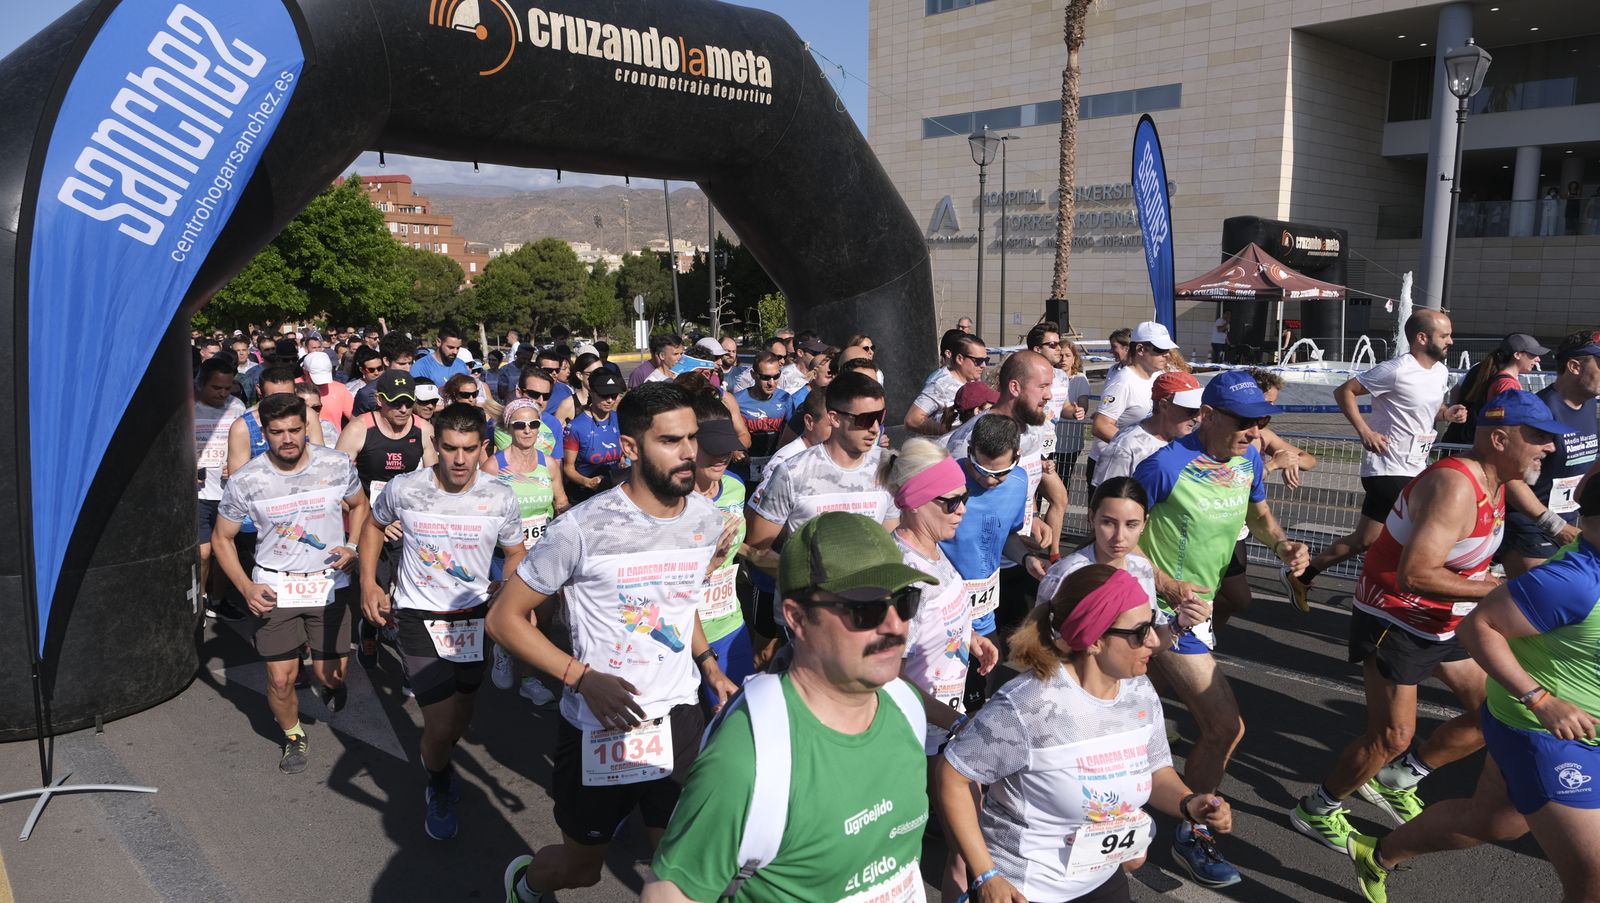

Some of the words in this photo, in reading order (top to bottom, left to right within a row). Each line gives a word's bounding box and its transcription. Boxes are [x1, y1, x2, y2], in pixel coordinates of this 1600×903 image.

[614, 67, 710, 96] cronometraje
[713, 83, 773, 106] deportivo
[171, 69, 294, 264] centrohogarsanchez.es
[386, 452, 402, 461] YES
[284, 581, 329, 595] 1037
[704, 582, 733, 604] 1096
[970, 586, 995, 608] 147
[435, 632, 476, 649] 1041
[594, 735, 663, 765] 1034
[1101, 829, 1136, 855] 94
[862, 856, 897, 884] Ejido
